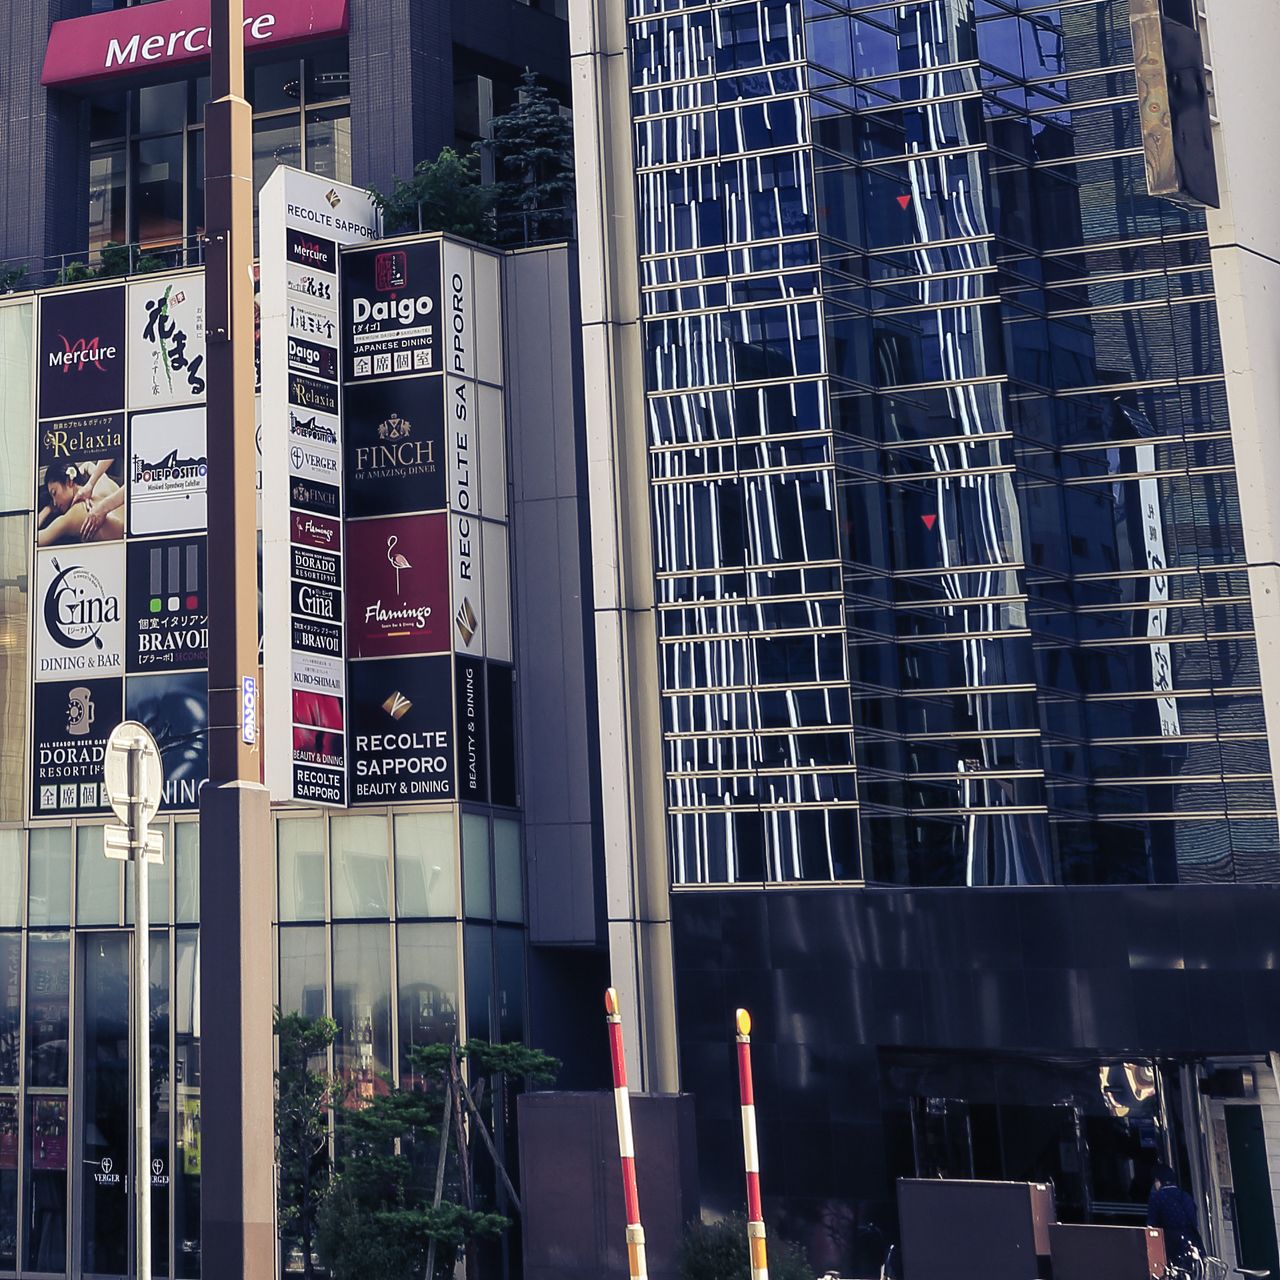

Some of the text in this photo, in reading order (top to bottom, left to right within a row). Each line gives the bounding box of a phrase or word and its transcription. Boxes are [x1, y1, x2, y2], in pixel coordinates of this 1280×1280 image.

[287, 203, 333, 227] RECOLTE
[293, 243, 328, 263] Mercure
[353, 292, 434, 325] Daigo
[48, 344, 117, 368] Mercure
[288, 339, 320, 364] Daigo
[354, 336, 433, 354] JAPANESE DINING
[354, 349, 432, 377] 全席個室
[296, 382, 336, 408] Relaxia
[452, 273, 472, 581] RECOLTE SAPPORO
[53, 428, 122, 458] Relaxia
[304, 453, 338, 472] VERGER
[355, 439, 435, 471] FINCH
[136, 469, 163, 484] POLE
[305, 519, 334, 542] Flamingo
[295, 554, 336, 572] DORADO
[295, 568, 320, 580] RESORT
[53, 586, 121, 626] Gina
[298, 585, 334, 618] Gina
[365, 599, 432, 629] Flamingo
[40, 653, 121, 672] DINING & BAR
[465, 668, 475, 718] DINING
[245, 679, 255, 741] C026
[355, 730, 448, 752] RECOLTE
[293, 749, 315, 762] BEAUTY
[322, 754, 344, 766] DINING
[356, 756, 448, 776] SAPPORO
[467, 737, 477, 789] BEAUTY
[39, 765, 88, 778] RESORT
[297, 769, 341, 787] RECOLTE
[297, 784, 340, 800] SAPPORO
[356, 779, 450, 796] BEAUTY & DINING
[94, 1173, 120, 1183] VERGER
